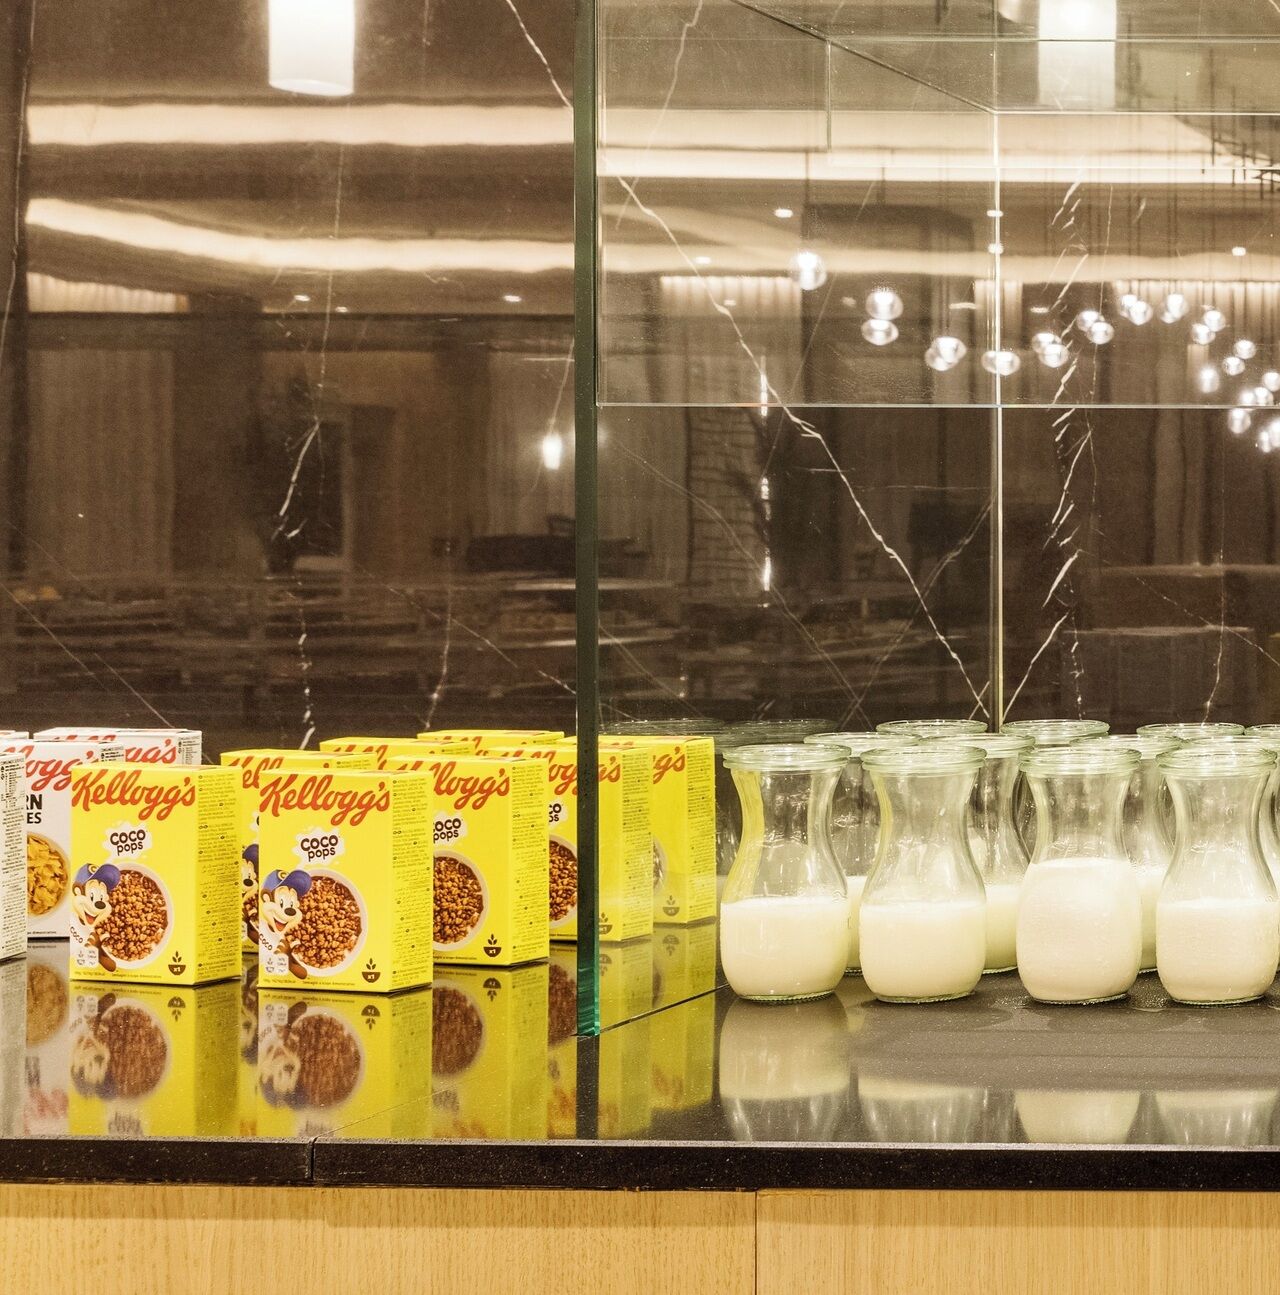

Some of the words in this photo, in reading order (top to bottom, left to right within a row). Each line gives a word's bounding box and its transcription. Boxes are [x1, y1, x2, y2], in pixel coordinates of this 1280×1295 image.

[71, 769, 196, 821] Kellogg's
[259, 774, 390, 827] Kellogg's
[432, 817, 462, 833] OCO
[433, 828, 460, 844] pops
[116, 841, 144, 857] pops
[307, 847, 337, 862] pops
